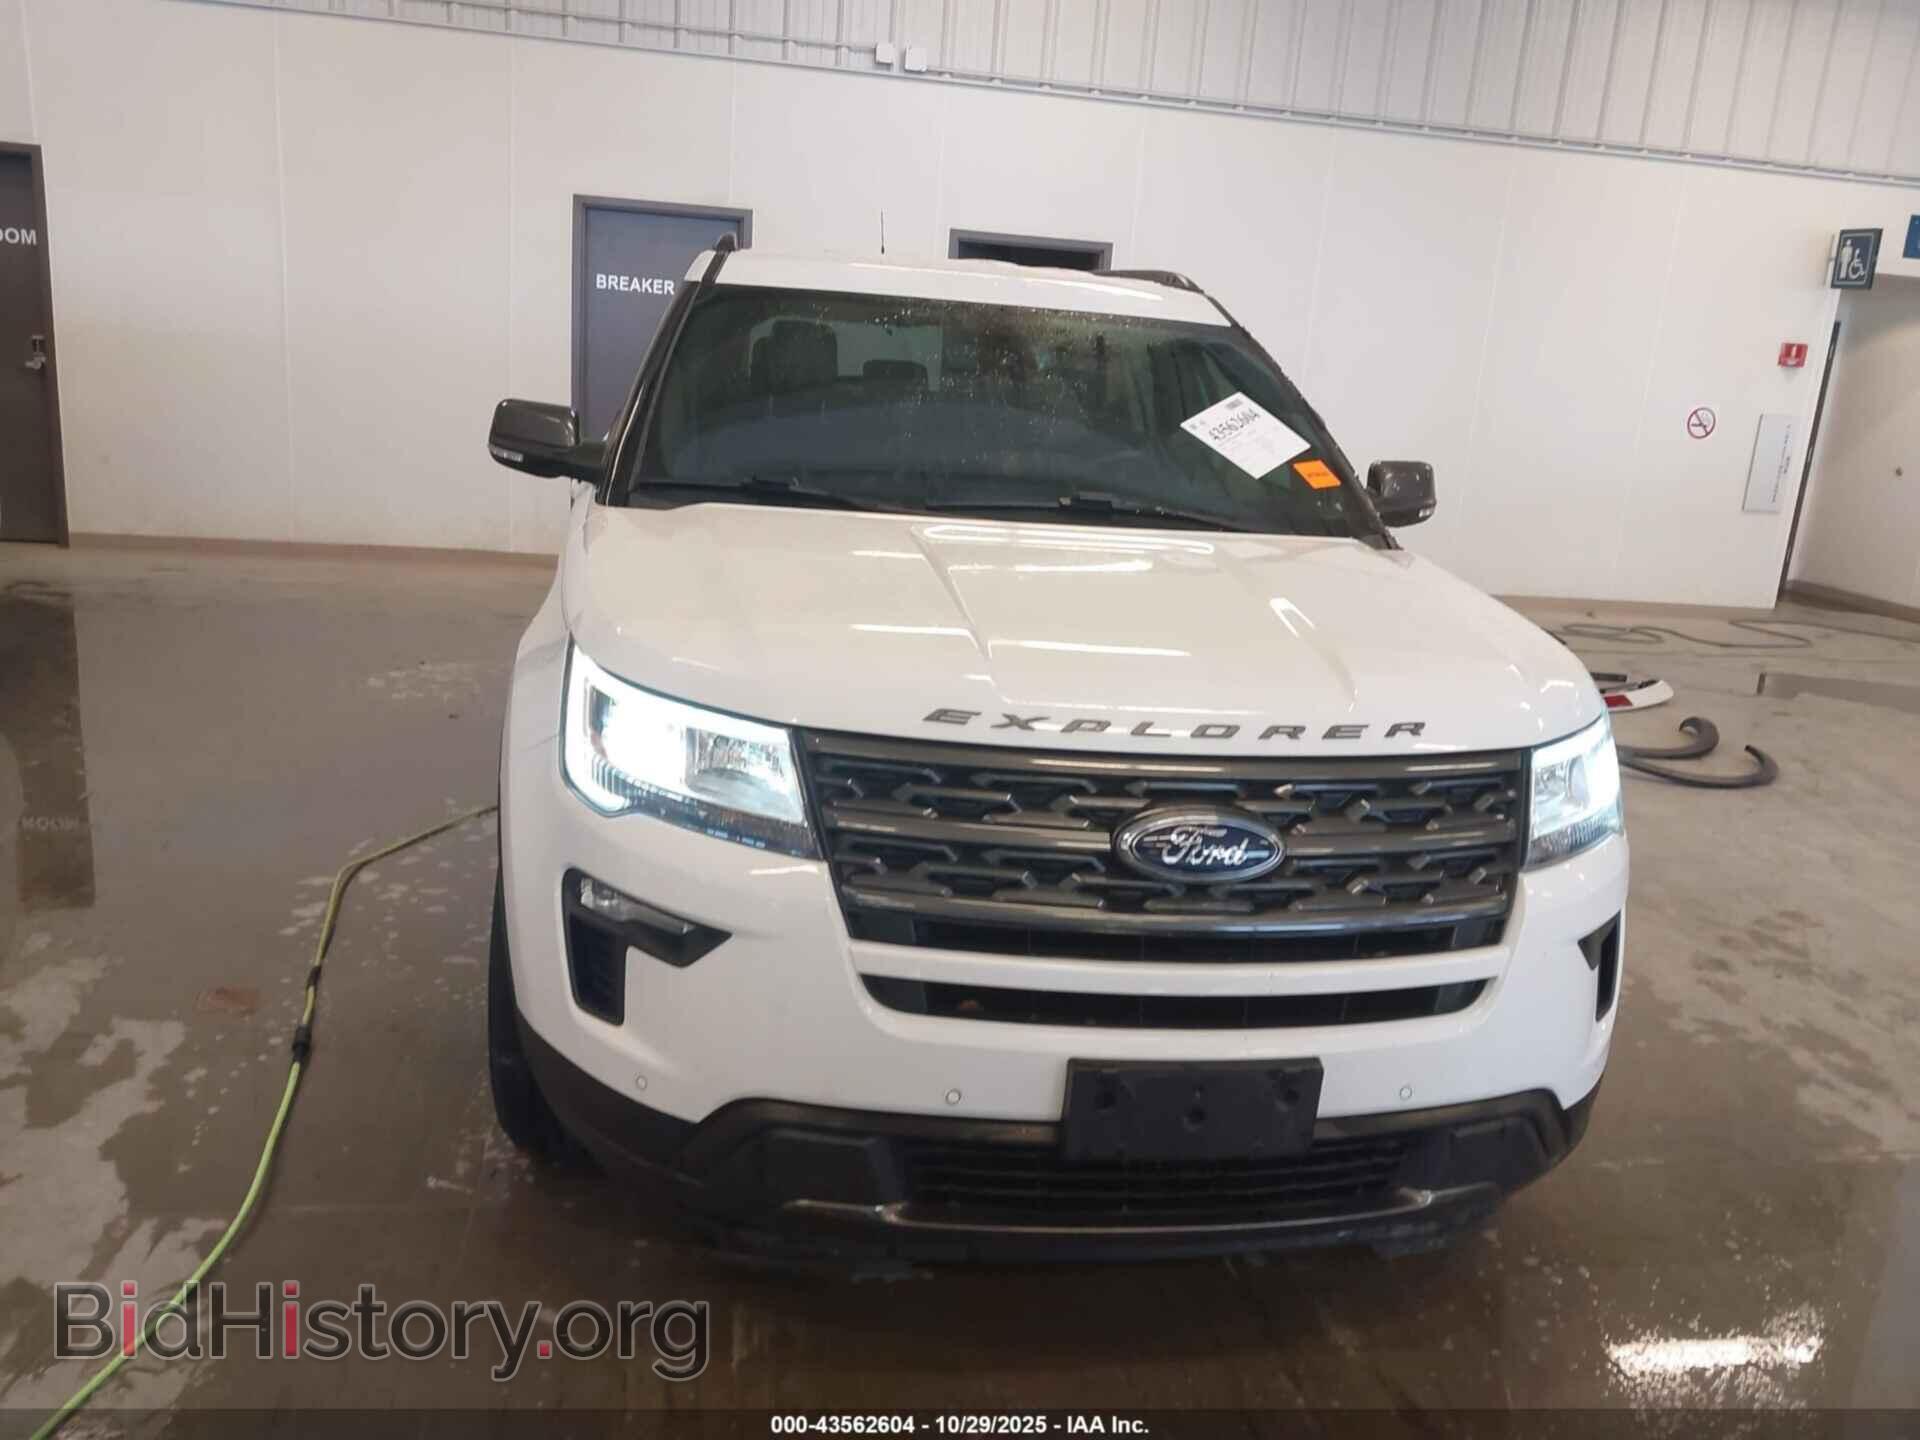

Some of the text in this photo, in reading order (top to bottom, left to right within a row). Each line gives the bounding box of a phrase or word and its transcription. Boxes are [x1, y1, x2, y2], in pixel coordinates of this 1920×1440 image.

[0, 227, 37, 245] OM
[596, 273, 675, 295] BREAKER
[922, 708, 1426, 740] EXPLORER
[1161, 826, 1249, 866] Ford
